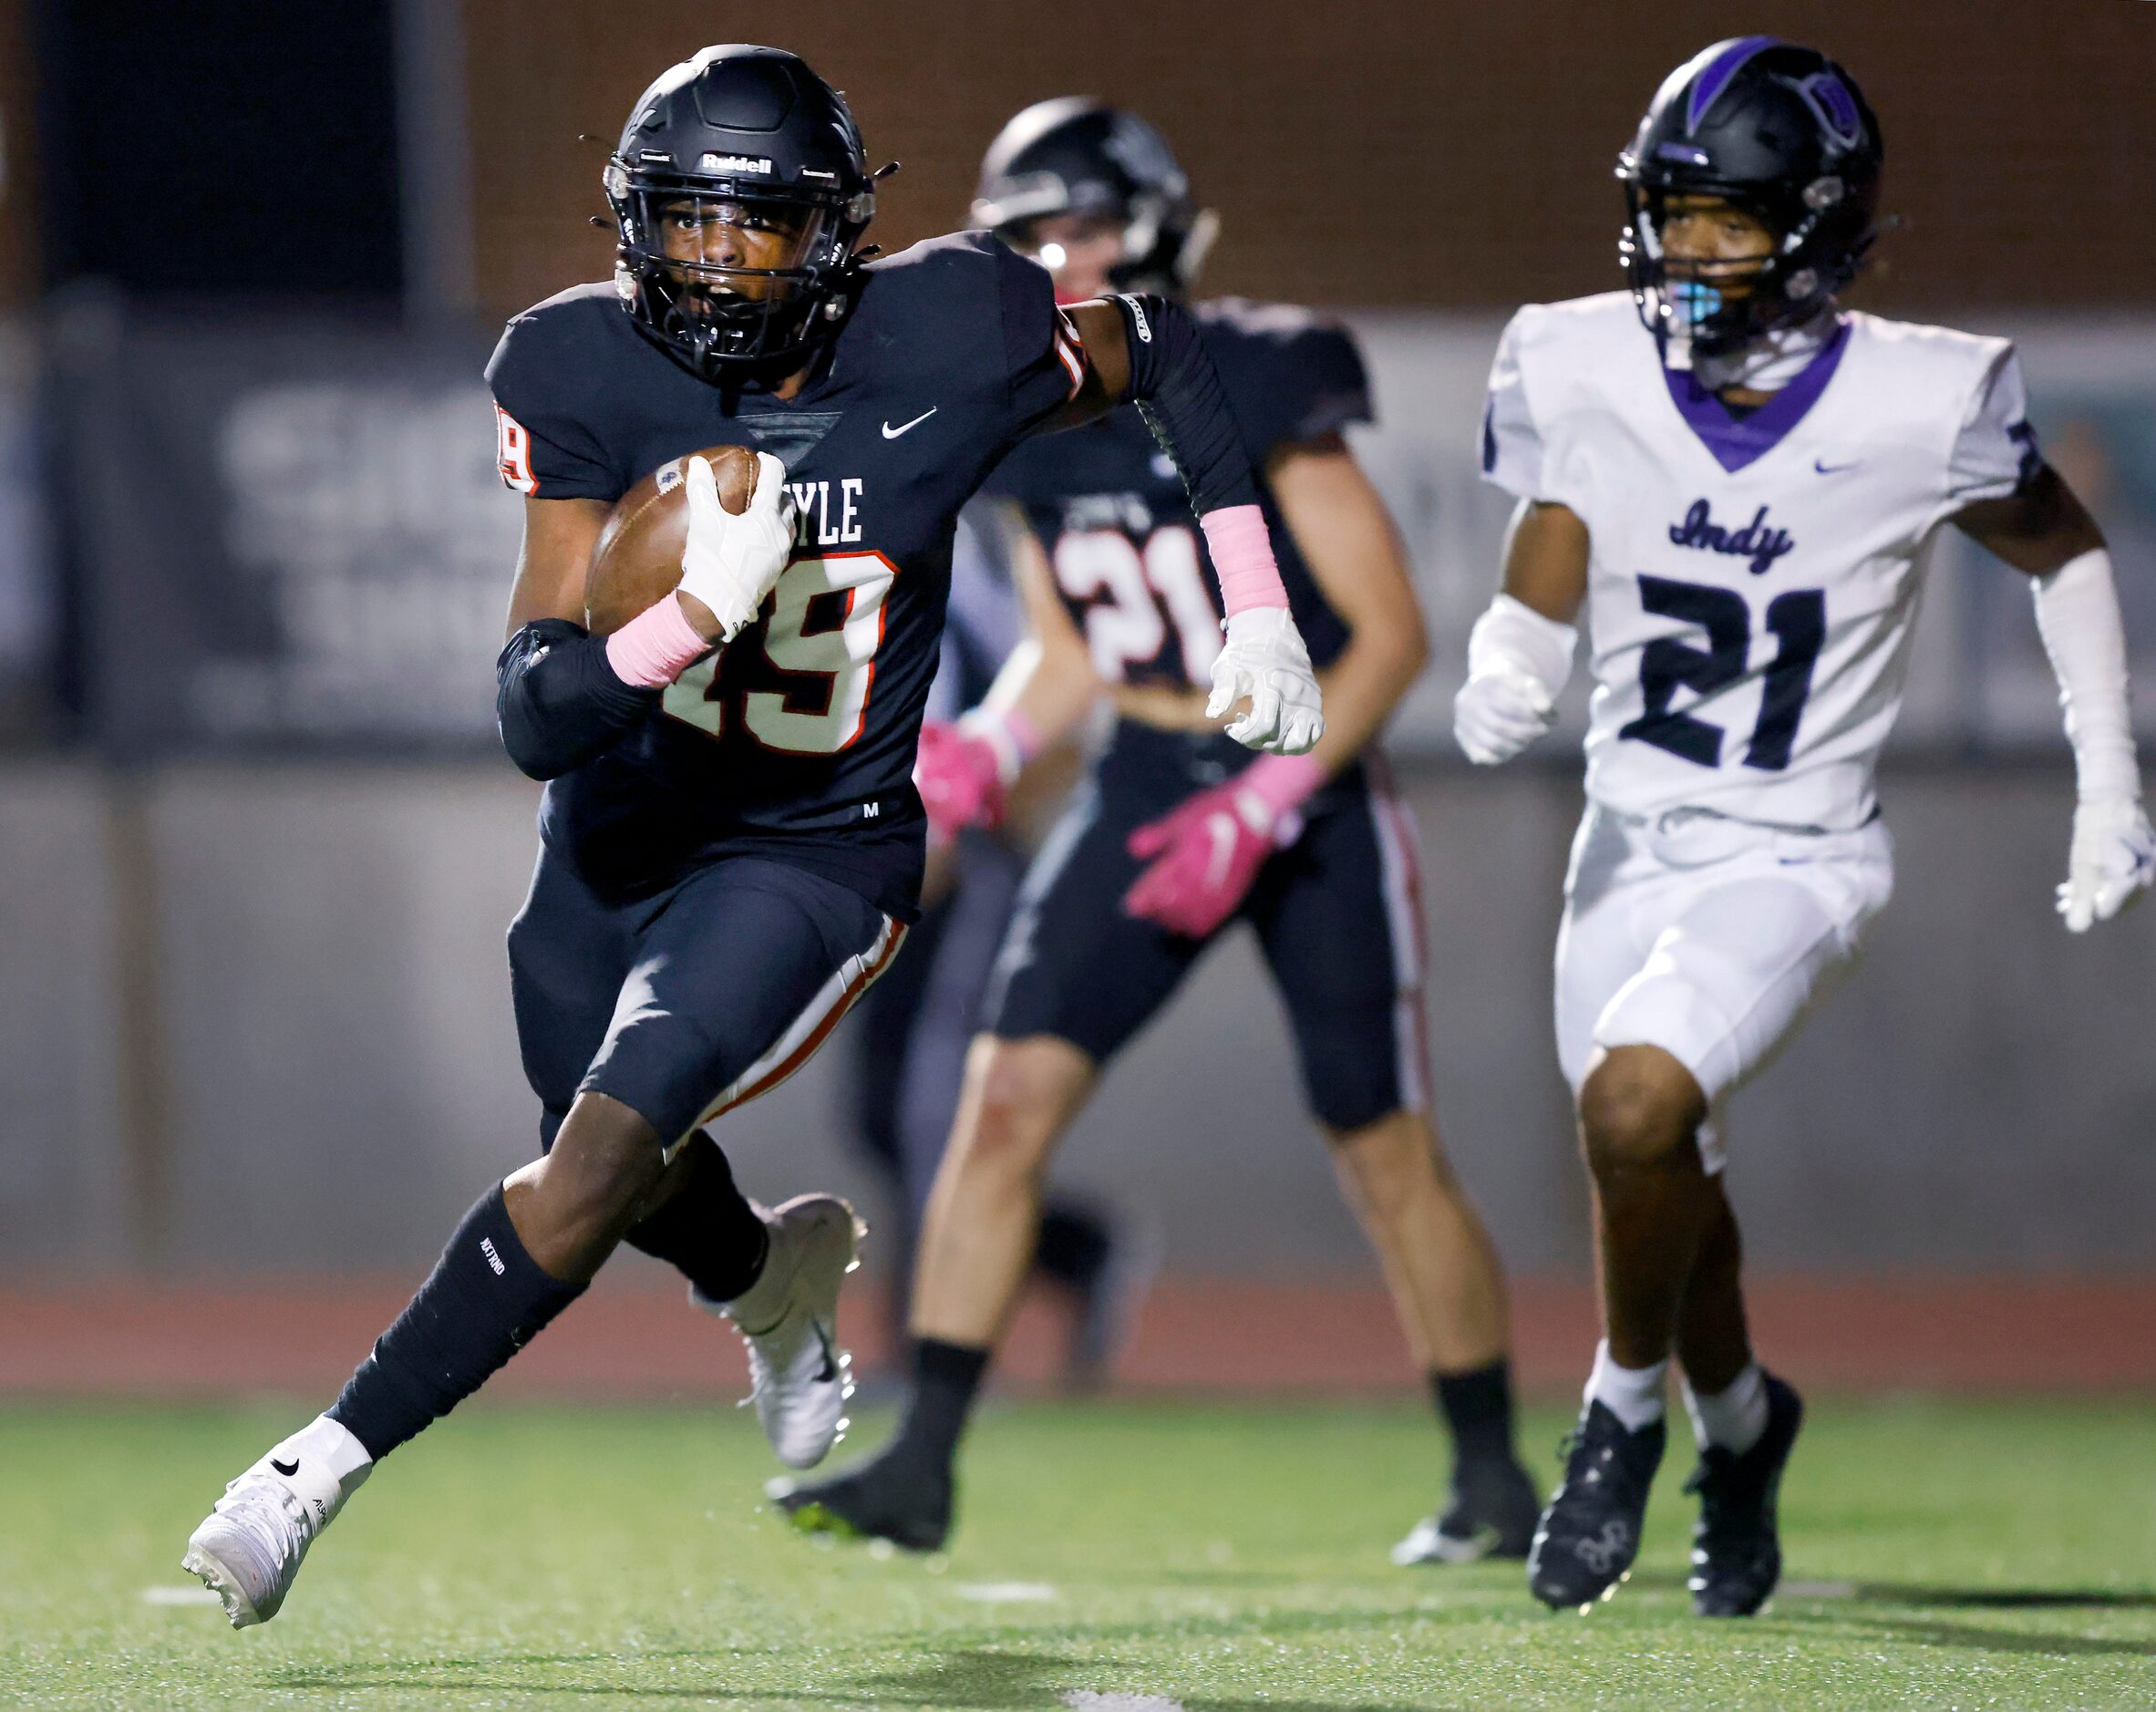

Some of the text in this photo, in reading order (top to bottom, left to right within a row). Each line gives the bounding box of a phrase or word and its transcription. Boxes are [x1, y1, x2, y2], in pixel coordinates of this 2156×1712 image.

[702, 152, 771, 174] Riddell
[782, 479, 862, 546] YLE
[1669, 499, 1794, 574] Indy
[1054, 525, 1226, 688] 21
[1618, 573, 1827, 770] 21
[862, 801, 879, 819] M
[480, 1236, 505, 1276] NXTRND
